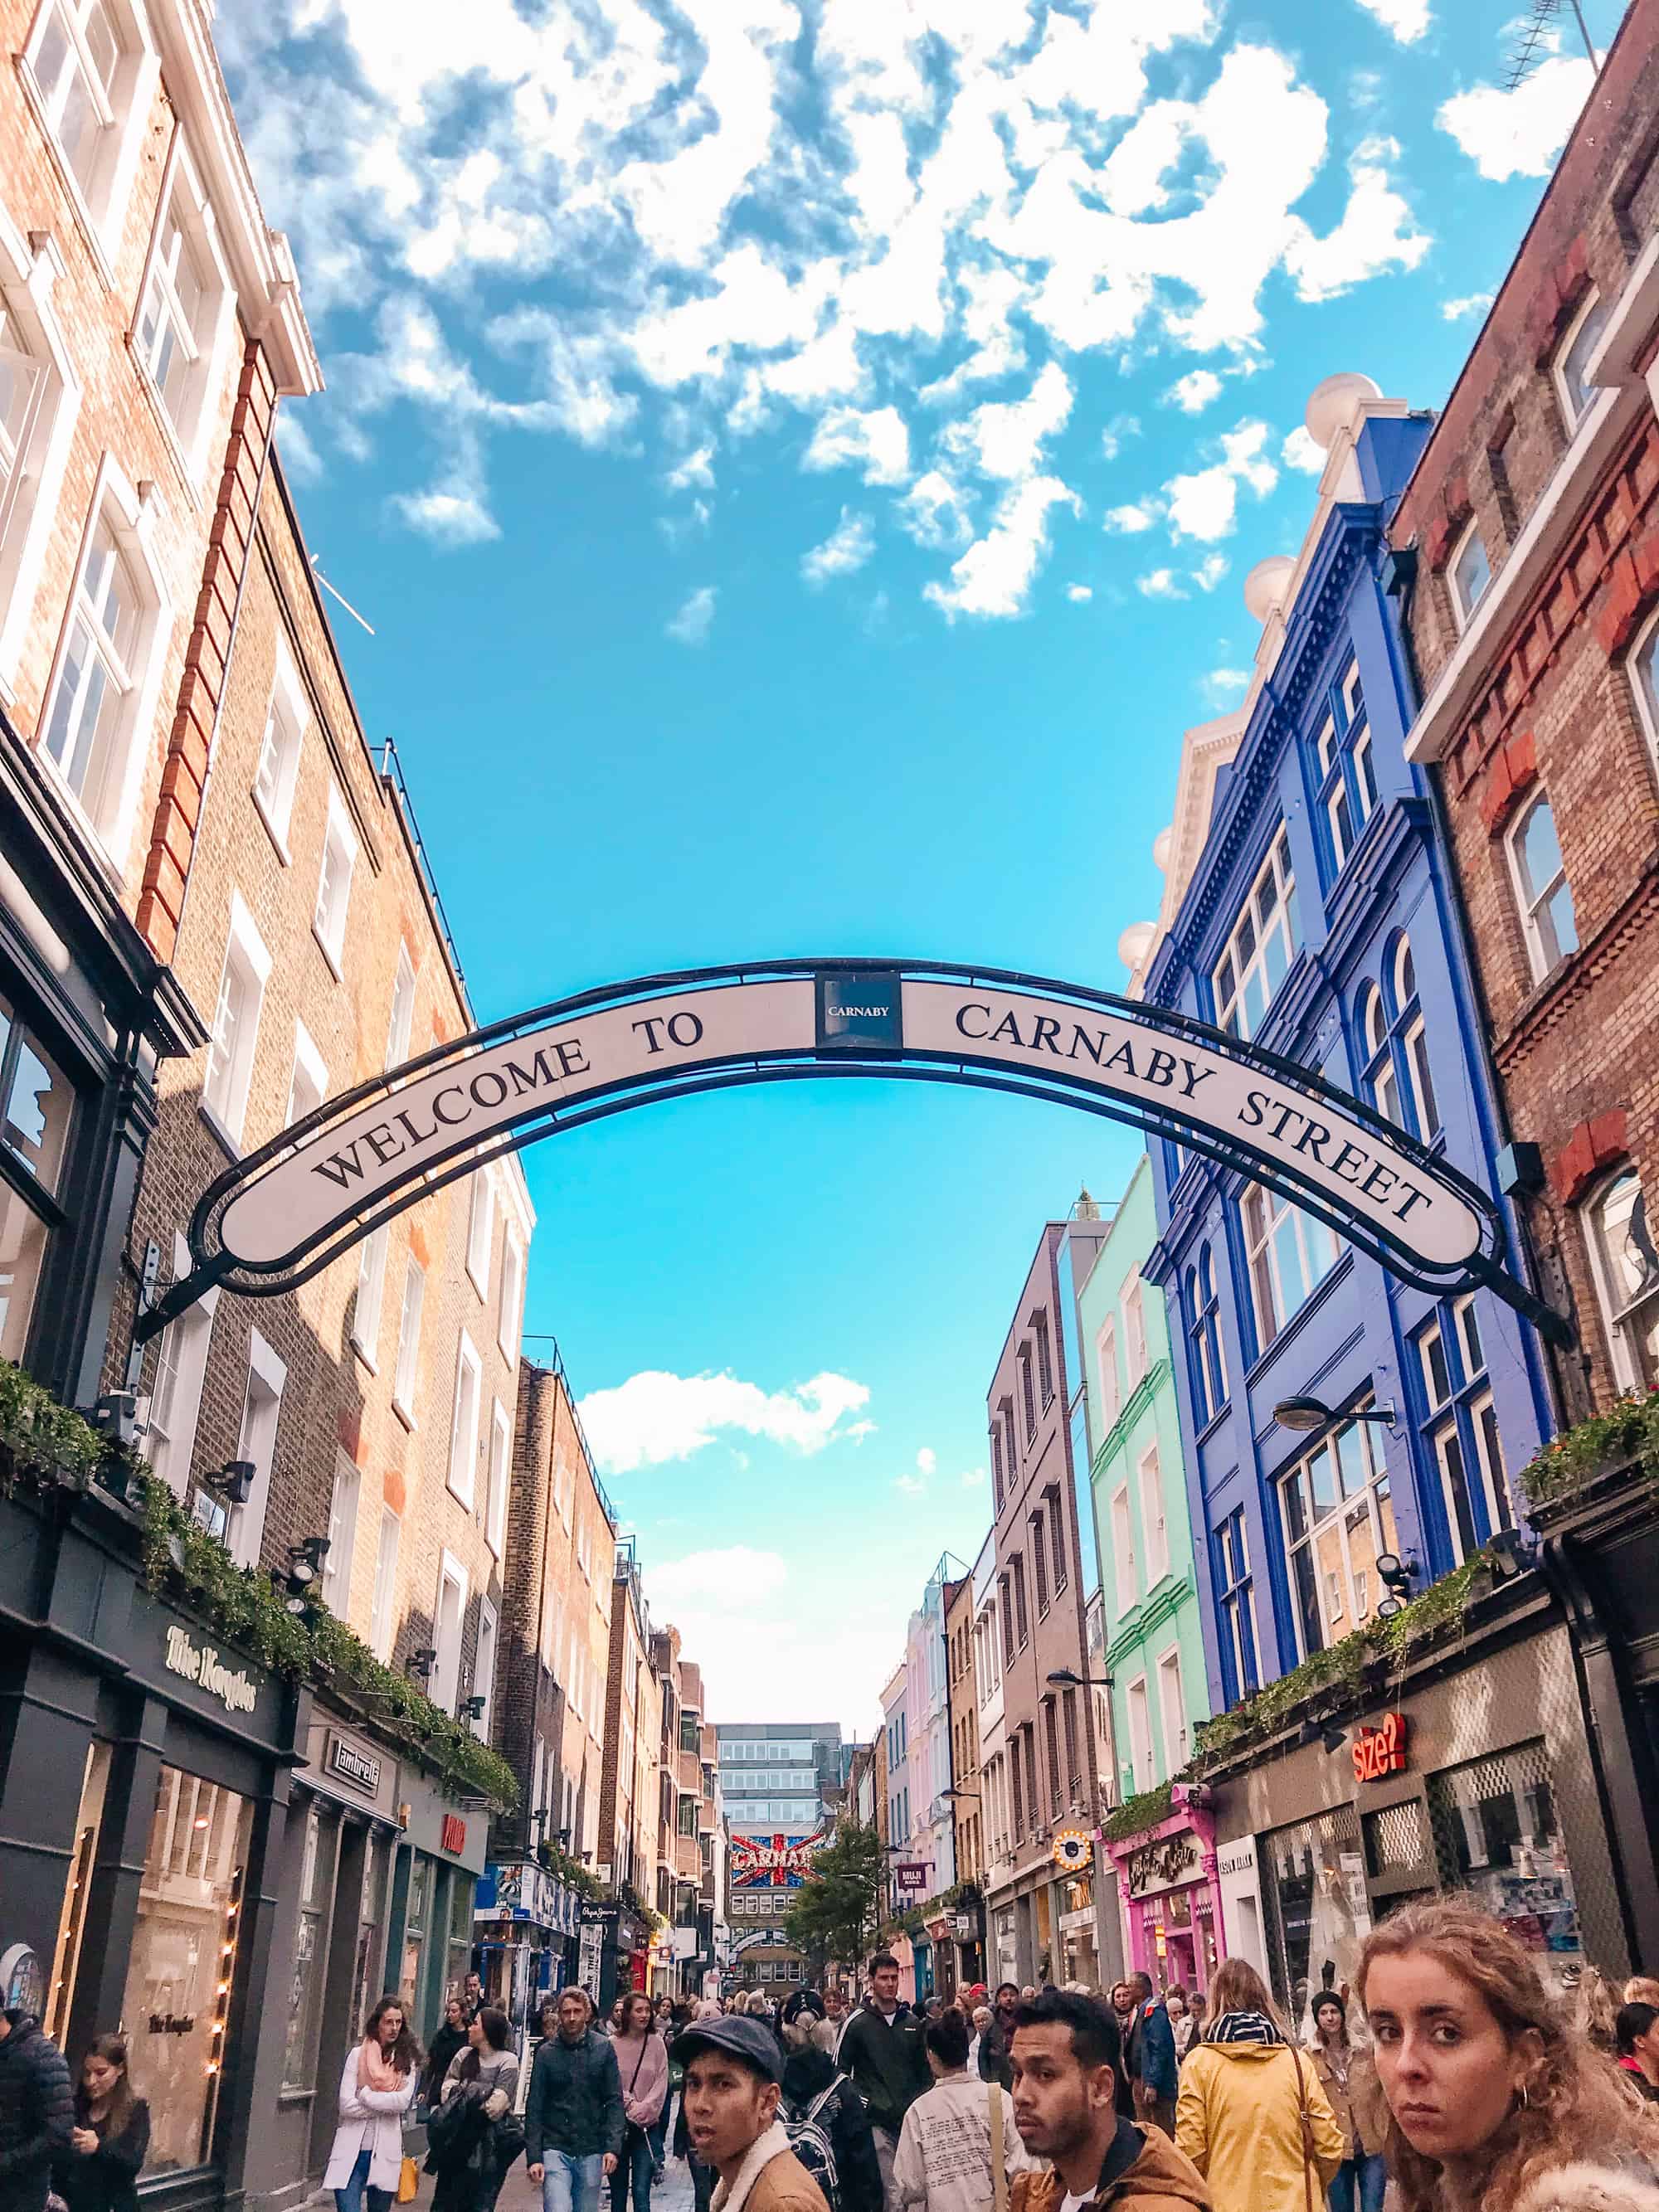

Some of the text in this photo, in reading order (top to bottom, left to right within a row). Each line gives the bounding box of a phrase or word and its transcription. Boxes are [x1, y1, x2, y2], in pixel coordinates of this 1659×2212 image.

[828, 1006, 889, 1017] CARNABY
[311, 1004, 1433, 1223] WELCOME TO CARNABY STREET
[1352, 1713, 1397, 1783] size?
[902, 1870, 922, 1880] MUJI
